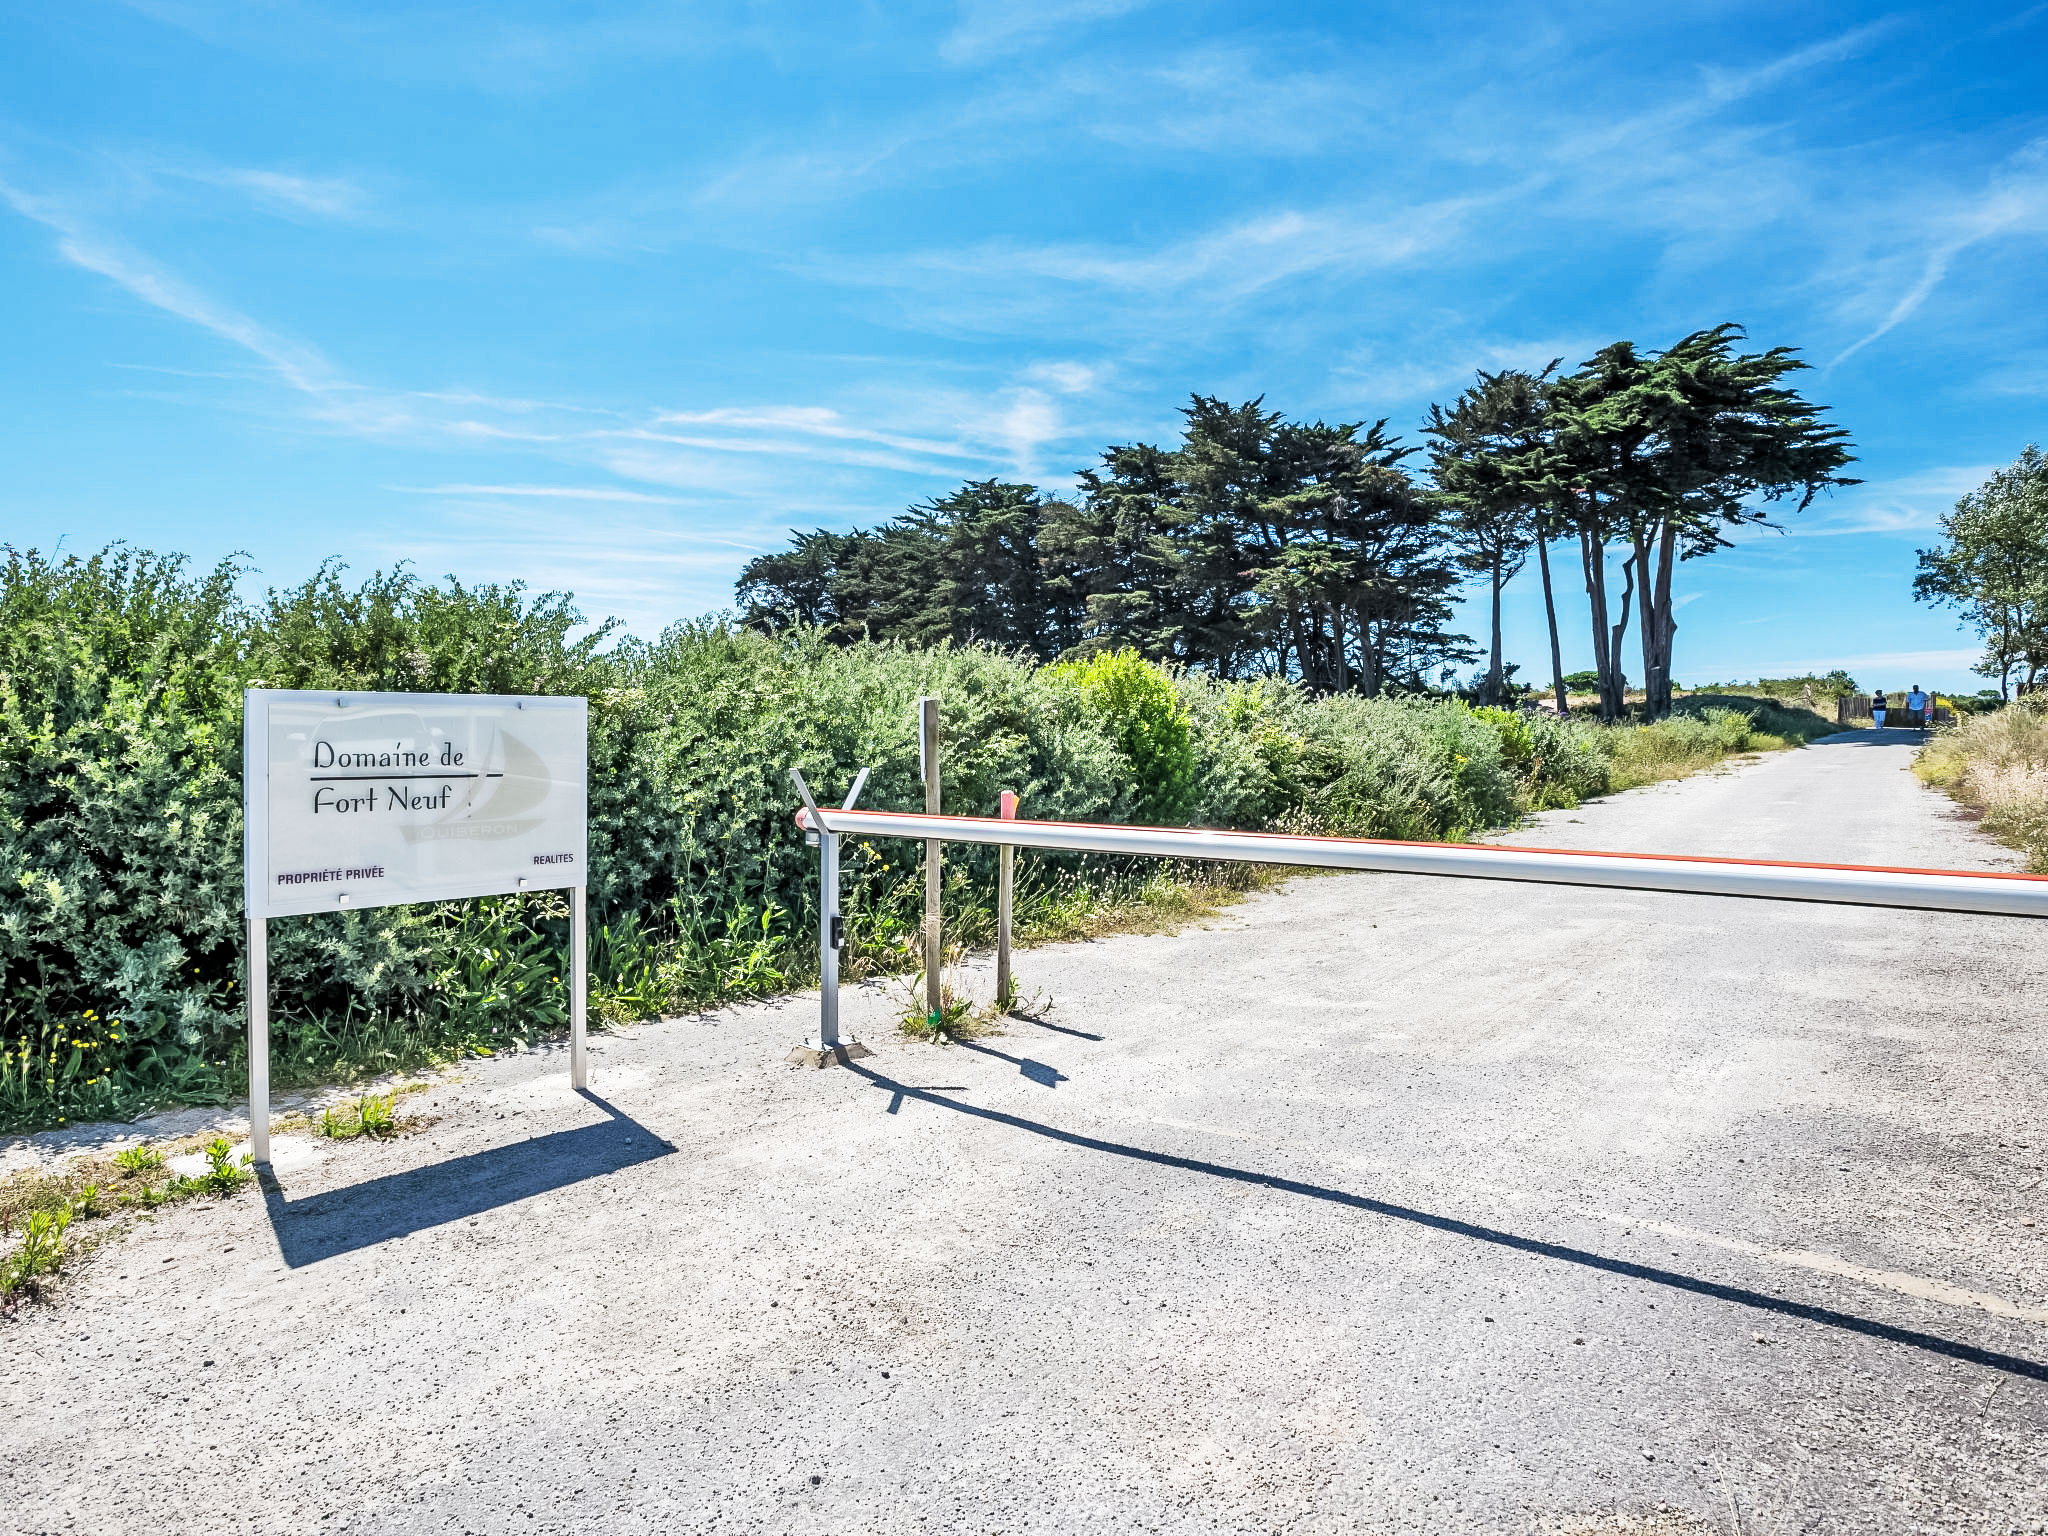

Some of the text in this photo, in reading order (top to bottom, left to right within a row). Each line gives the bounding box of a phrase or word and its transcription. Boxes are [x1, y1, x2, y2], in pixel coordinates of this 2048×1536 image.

[314, 741, 464, 768] Domaine de
[314, 785, 452, 814] Fort Neuf
[533, 853, 574, 865] REALITES
[277, 865, 385, 885] PROPRIÉTÉ PRIVÉE
